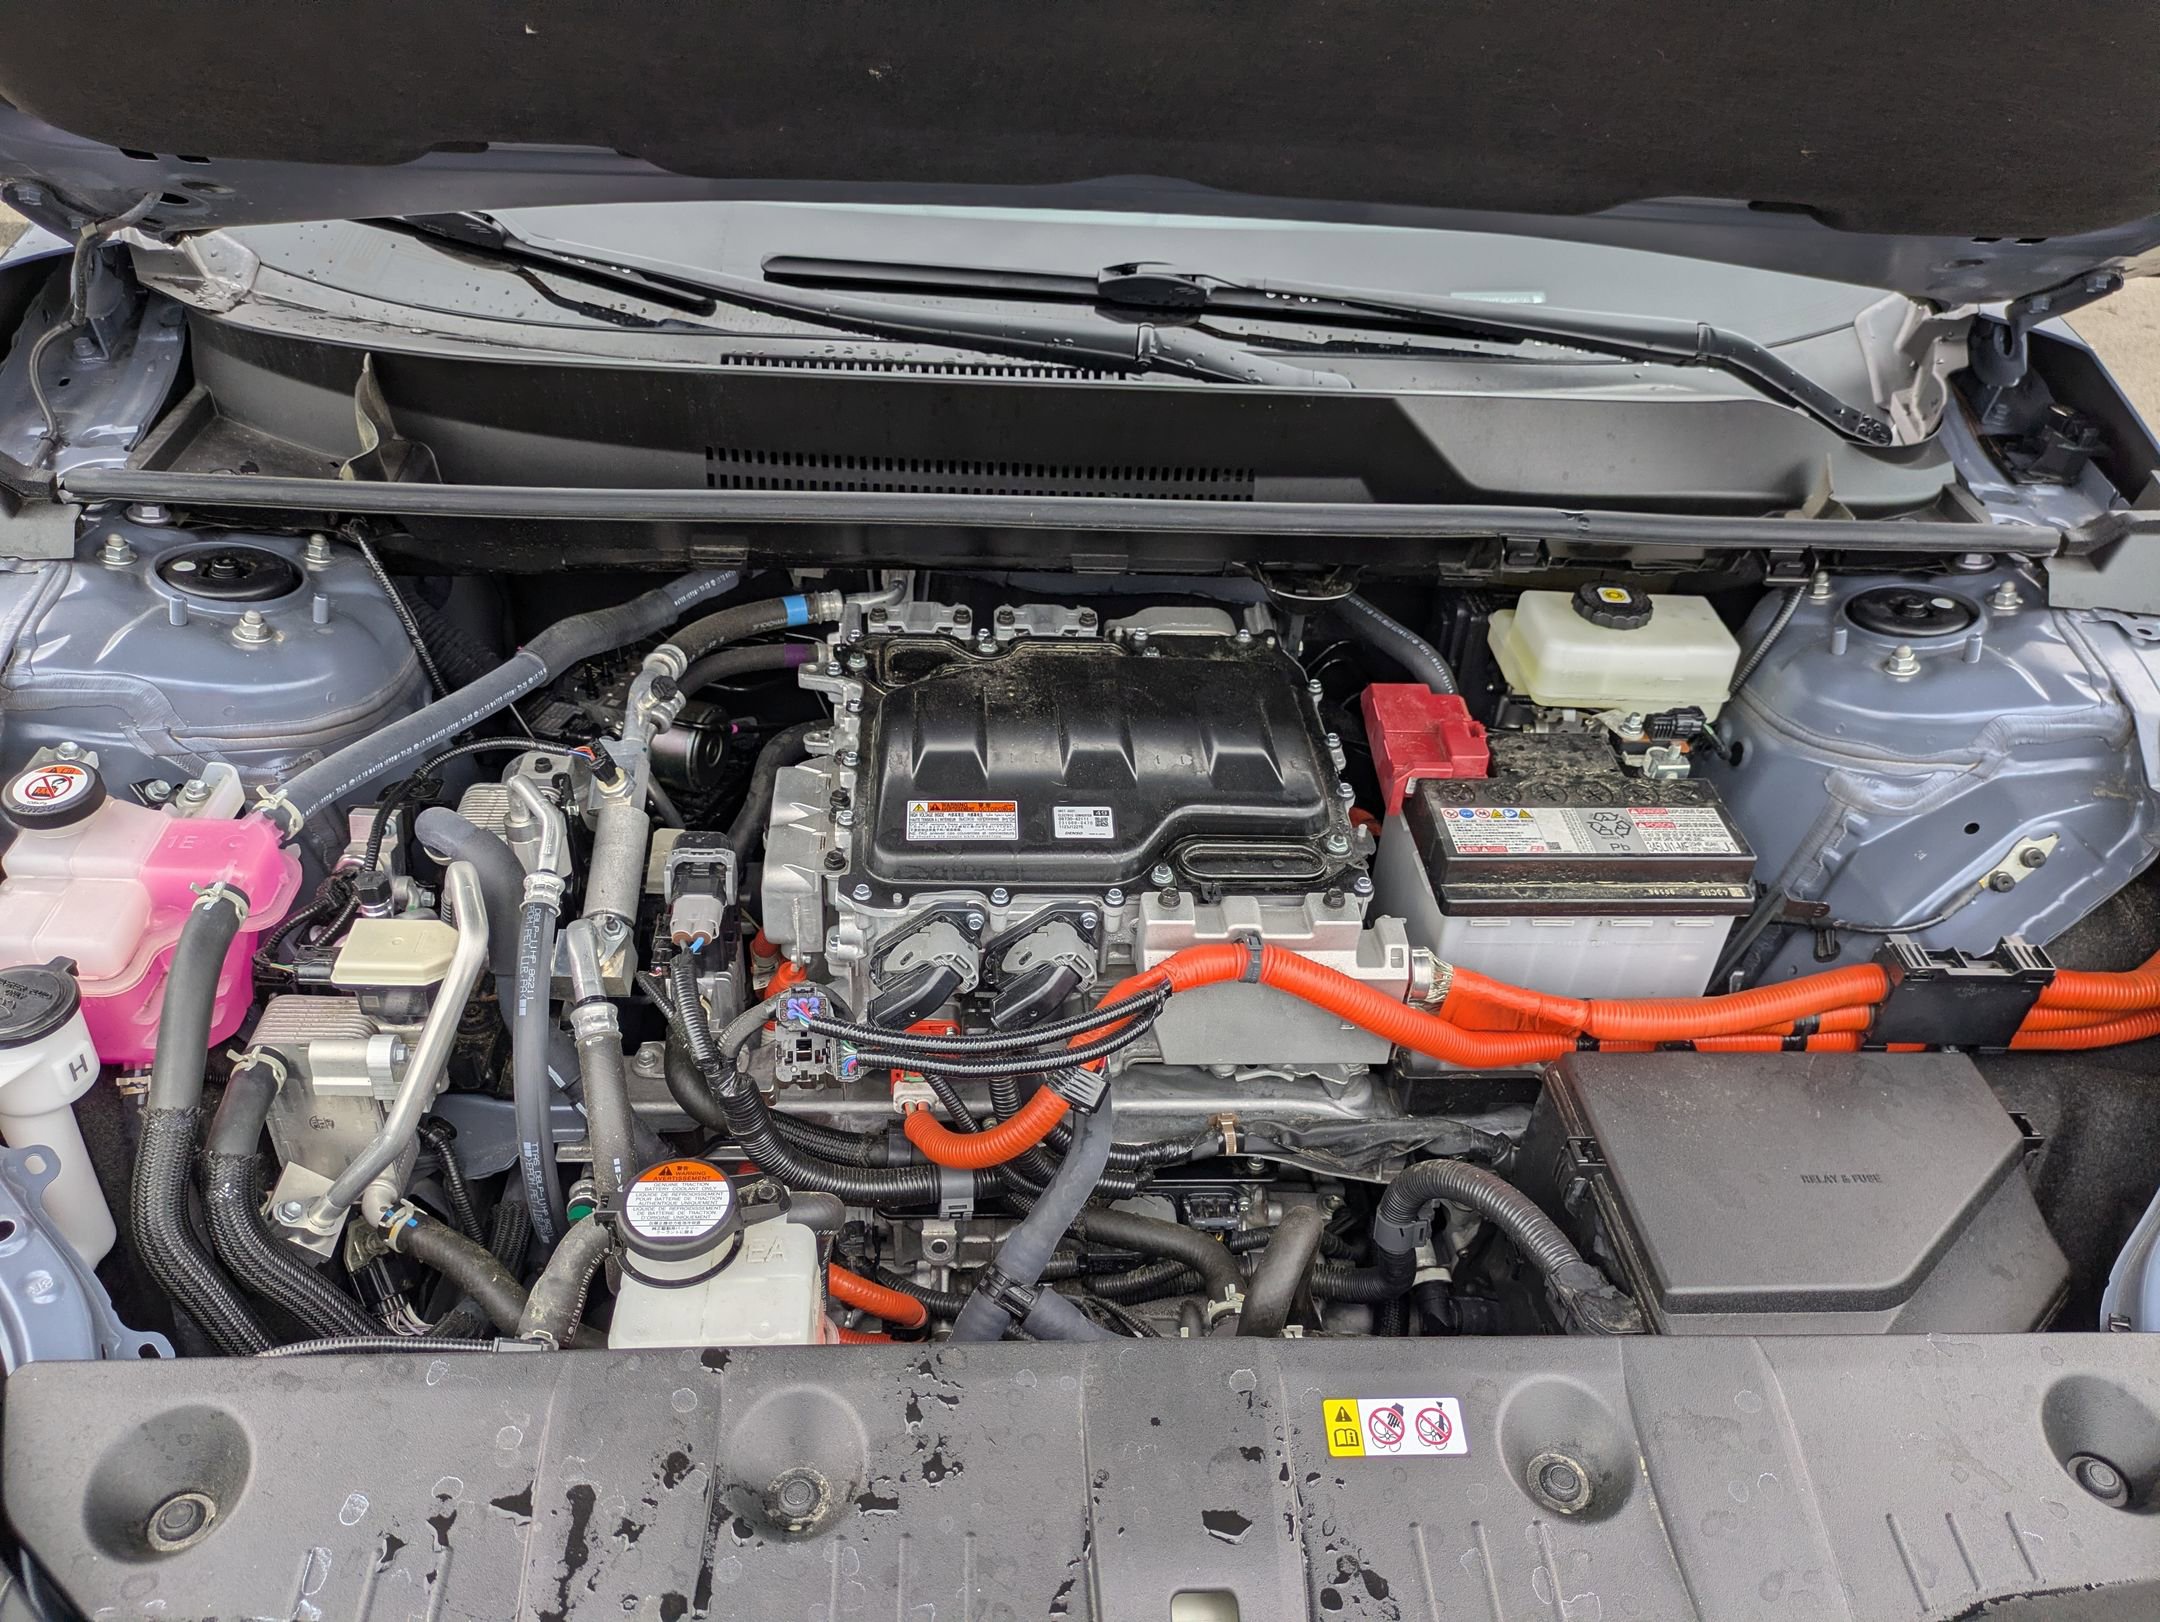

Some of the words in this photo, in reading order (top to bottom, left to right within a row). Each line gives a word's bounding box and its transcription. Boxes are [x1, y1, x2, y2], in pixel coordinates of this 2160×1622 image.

[1610, 843, 1631, 851] Pb
[69, 1054, 88, 1082] H
[1800, 1174, 1839, 1184] RELAY
[1841, 1174, 1851, 1184] &
[1852, 1173, 1884, 1184] FUSE
